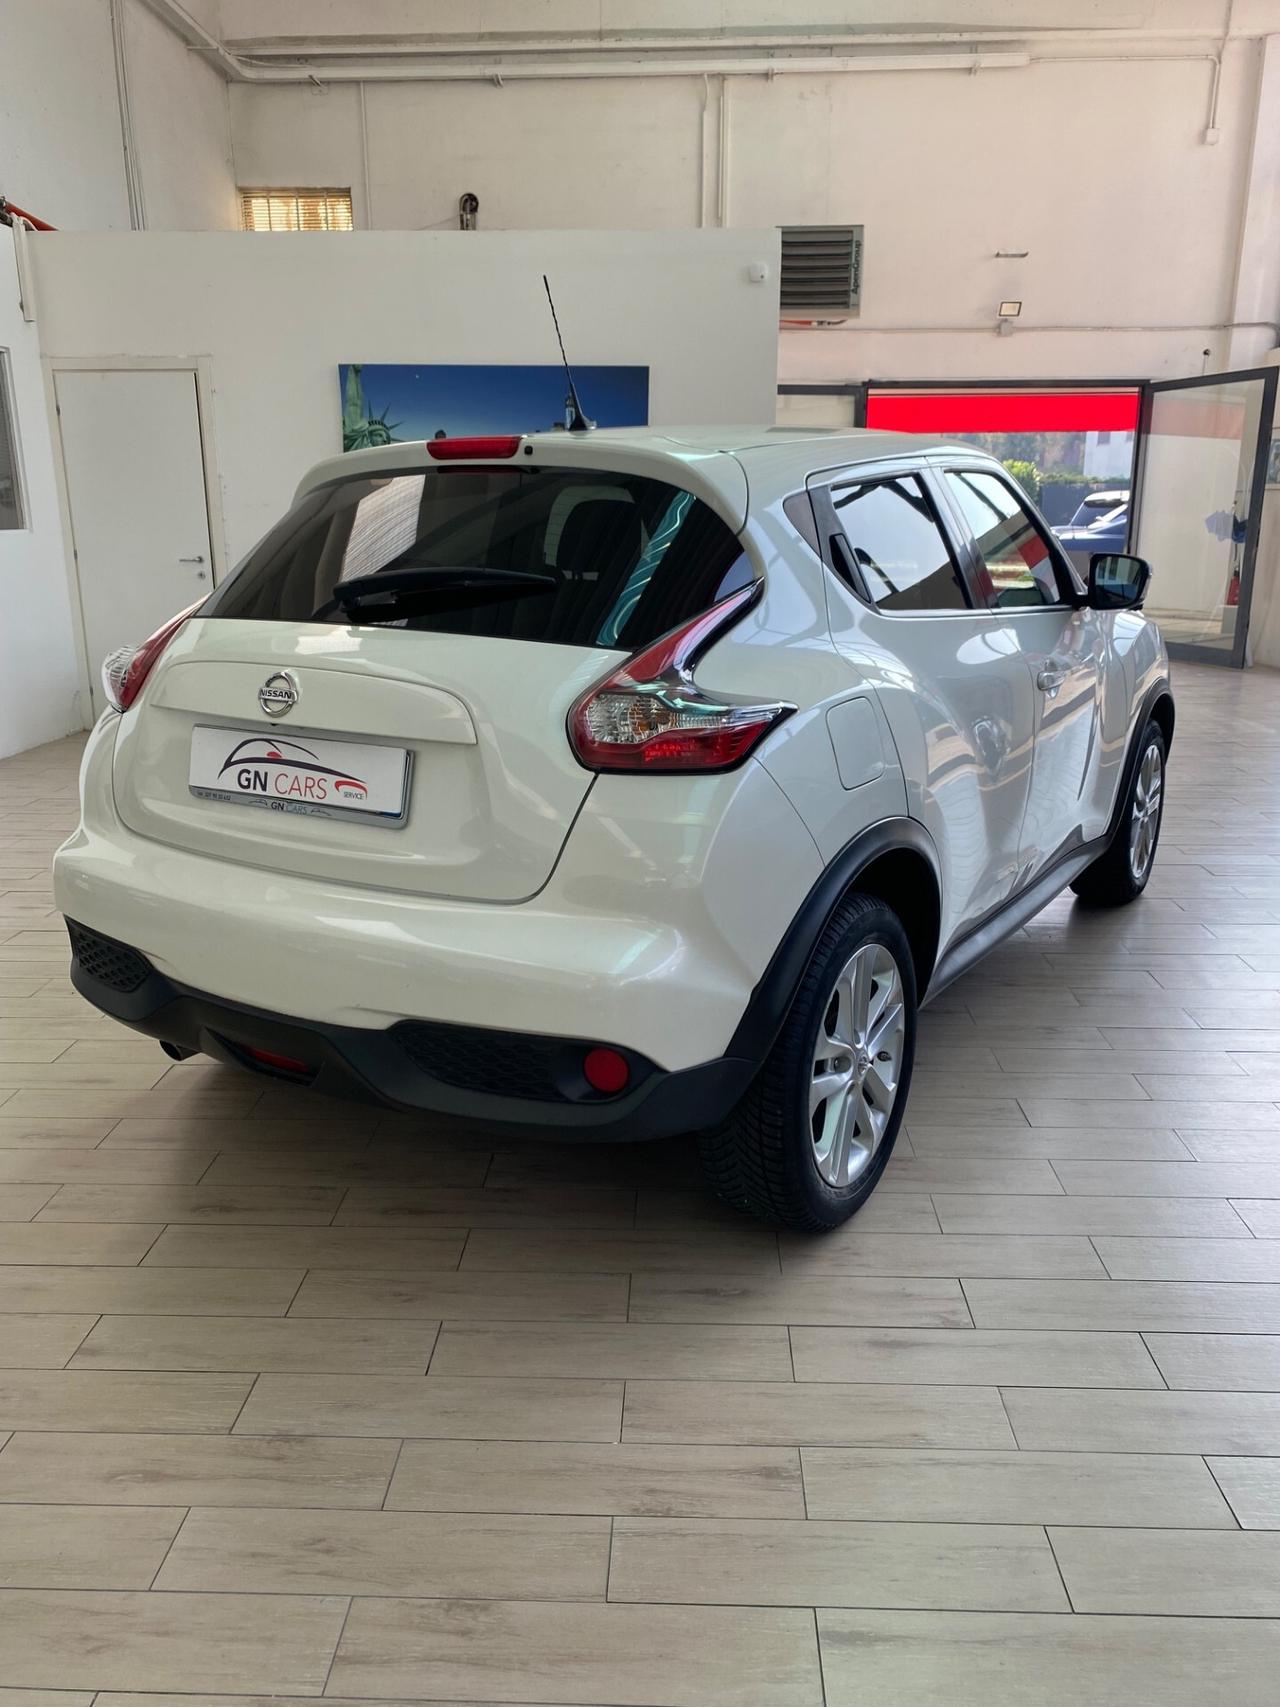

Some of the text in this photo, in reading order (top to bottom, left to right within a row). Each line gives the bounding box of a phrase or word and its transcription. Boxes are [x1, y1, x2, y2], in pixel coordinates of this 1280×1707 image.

[260, 689, 292, 699] NISSAN
[237, 768, 328, 800] GN CARS
[343, 791, 364, 800] SERVICE
[270, 801, 308, 816] GN CARS
